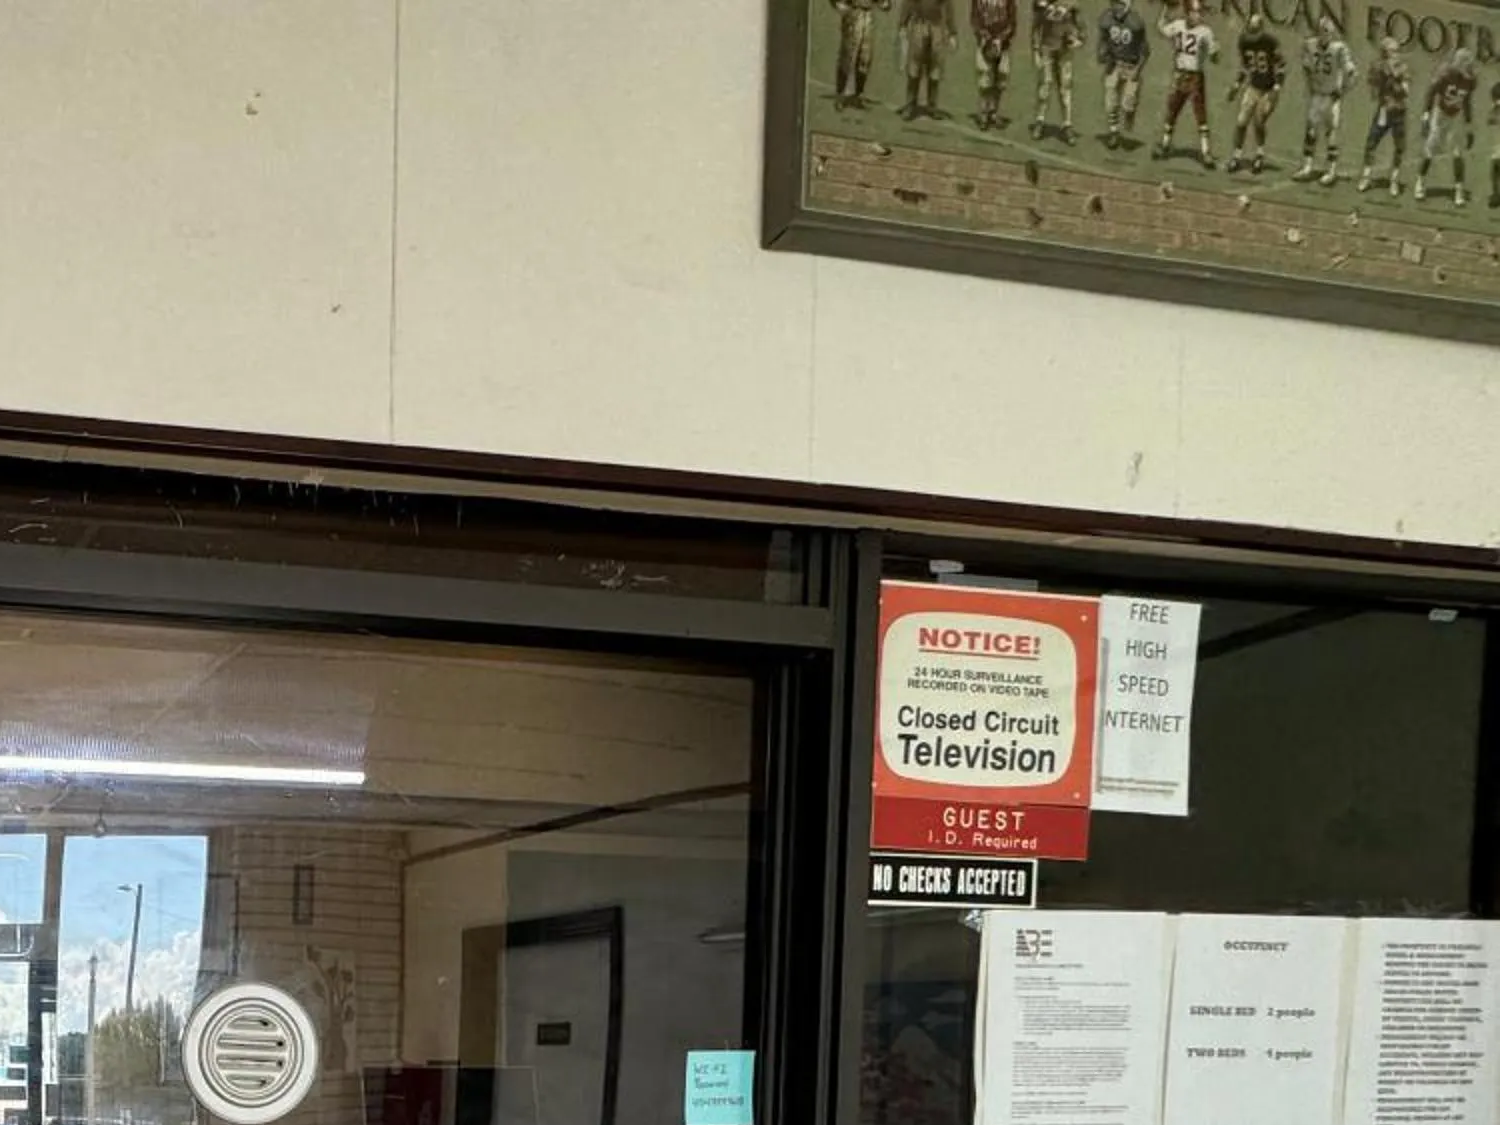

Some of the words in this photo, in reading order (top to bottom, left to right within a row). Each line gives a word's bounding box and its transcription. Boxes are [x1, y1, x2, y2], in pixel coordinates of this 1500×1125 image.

[1175, 31, 1197, 55] 12
[1366, 6, 1500, 63] FOOTB
[1129, 603, 1170, 625] FREE
[918, 627, 1041, 655] NOTICE!
[1125, 638, 1168, 660] HIGH
[914, 667, 928, 677] 24
[931, 668, 962, 679] HOUR
[963, 669, 1044, 685] SURVEILLANCE
[1117, 673, 1170, 697] SPEED
[907, 678, 968, 692] RECORDED
[969, 683, 986, 694] ON
[988, 684, 1020, 697] VIDEO
[1023, 686, 1050, 699] TAPE
[897, 705, 976, 731] Closed
[984, 711, 1060, 736] Circuit
[1104, 709, 1185, 733] NTERNET
[897, 733, 1056, 774] Television
[943, 807, 1026, 831] GUEST
[972, 831, 1038, 851] Required
[872, 864, 893, 892] NO
[899, 866, 951, 894] CHECKS
[957, 868, 1027, 897] ACCEPTED
